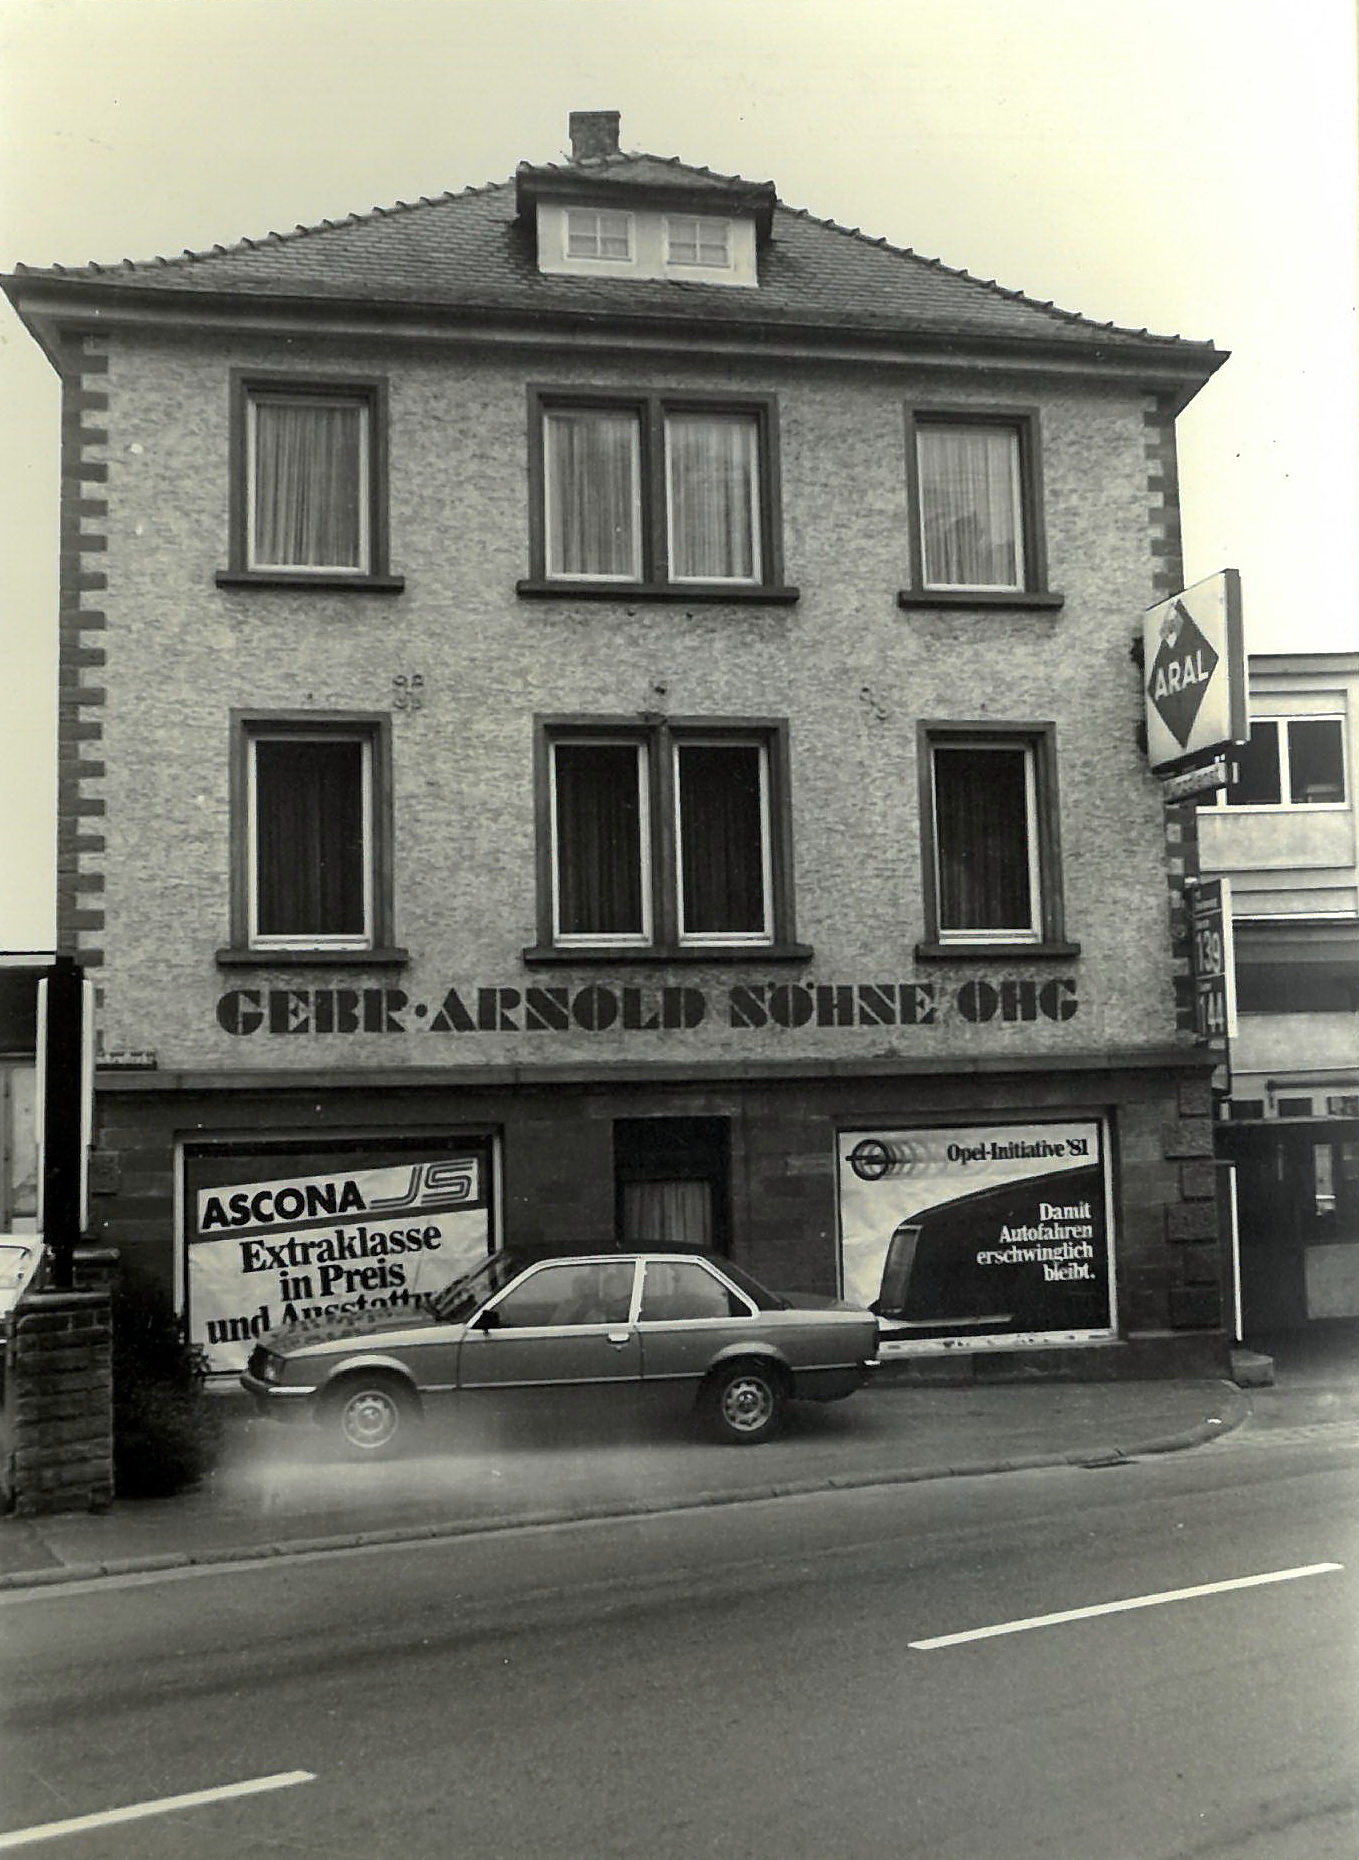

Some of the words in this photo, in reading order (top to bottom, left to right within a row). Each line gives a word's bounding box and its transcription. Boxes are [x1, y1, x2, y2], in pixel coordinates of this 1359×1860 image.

[1155, 650, 1209, 700] ARAL
[429, 986, 705, 1033] ARNOLD
[730, 981, 937, 1028] SÖHNE
[957, 978, 1079, 1022] OHG
[947, 1139, 1065, 1165] Opel-Initiative
[202, 1180, 366, 1230] ASCONA
[1039, 1202, 1092, 1221] Damit
[239, 1225, 442, 1273] Extraklasse
[1000, 1223, 1093, 1243] Autofahren
[976, 1241, 1094, 1265] erschwinglich
[1043, 1261, 1096, 1281] bleibt.
[280, 1271, 313, 1302] in
[318, 1258, 406, 1297] Preis
[206, 1306, 270, 1344] und
